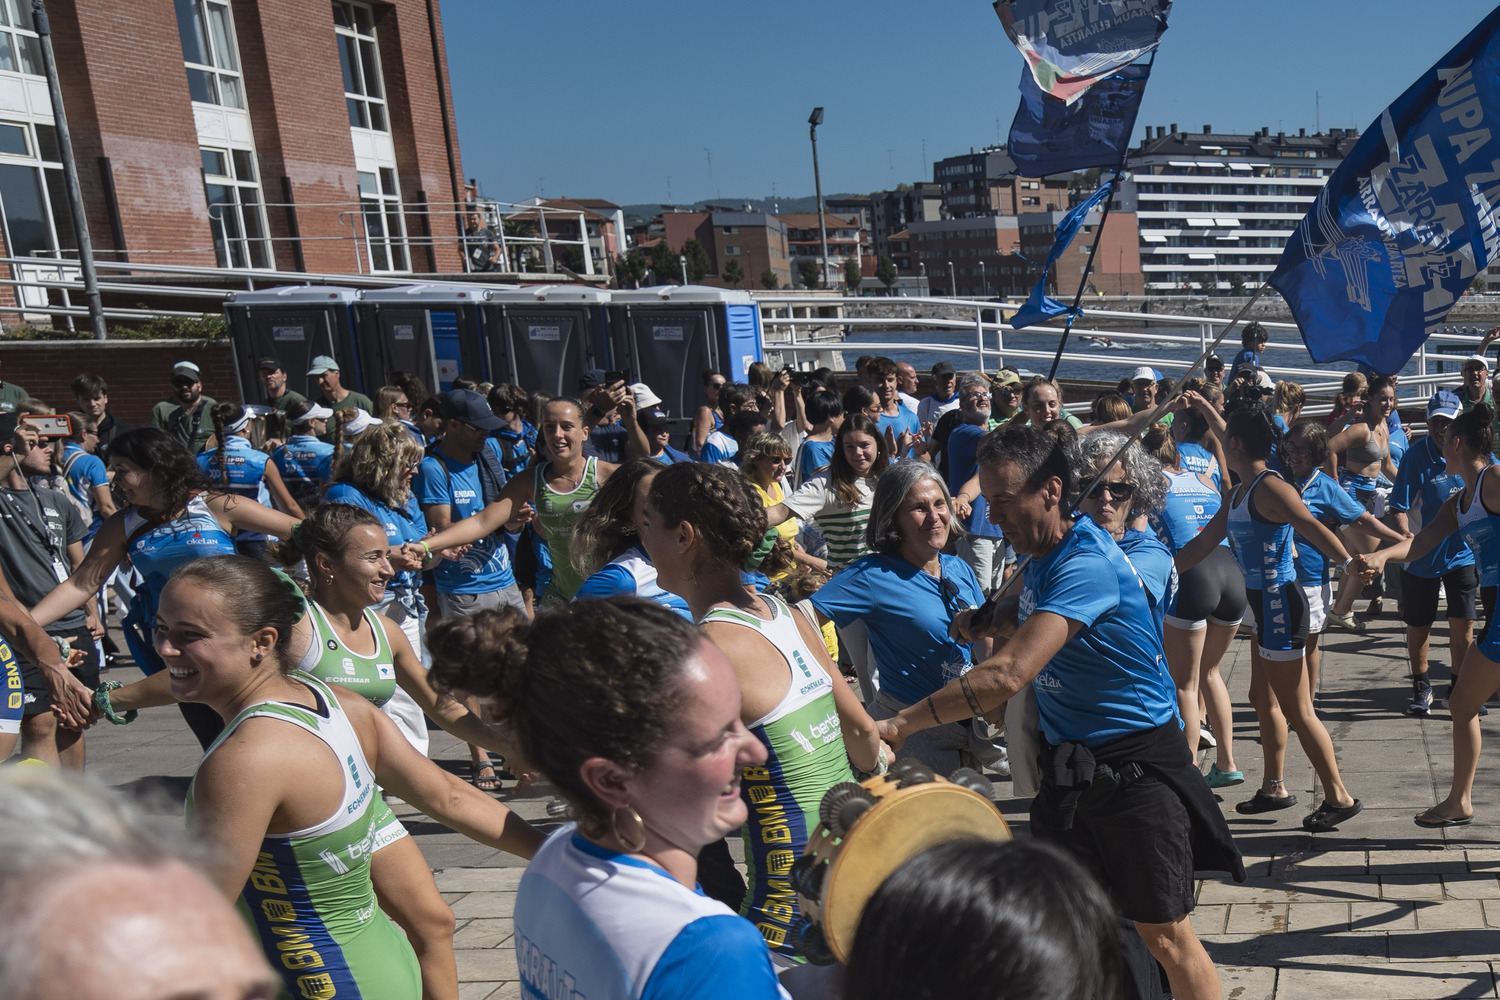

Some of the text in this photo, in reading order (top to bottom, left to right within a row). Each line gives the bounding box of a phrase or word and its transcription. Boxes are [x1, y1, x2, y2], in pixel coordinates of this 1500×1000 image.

[1437, 58, 1492, 165] AUPA
[1263, 541, 1286, 635] ZARAUTZ
[325, 676, 371, 684] ECHEMAR
[347, 783, 371, 815] ECHEMAR
[756, 805, 792, 844] BM
[762, 879, 797, 923] BM
[271, 926, 325, 970] BM
